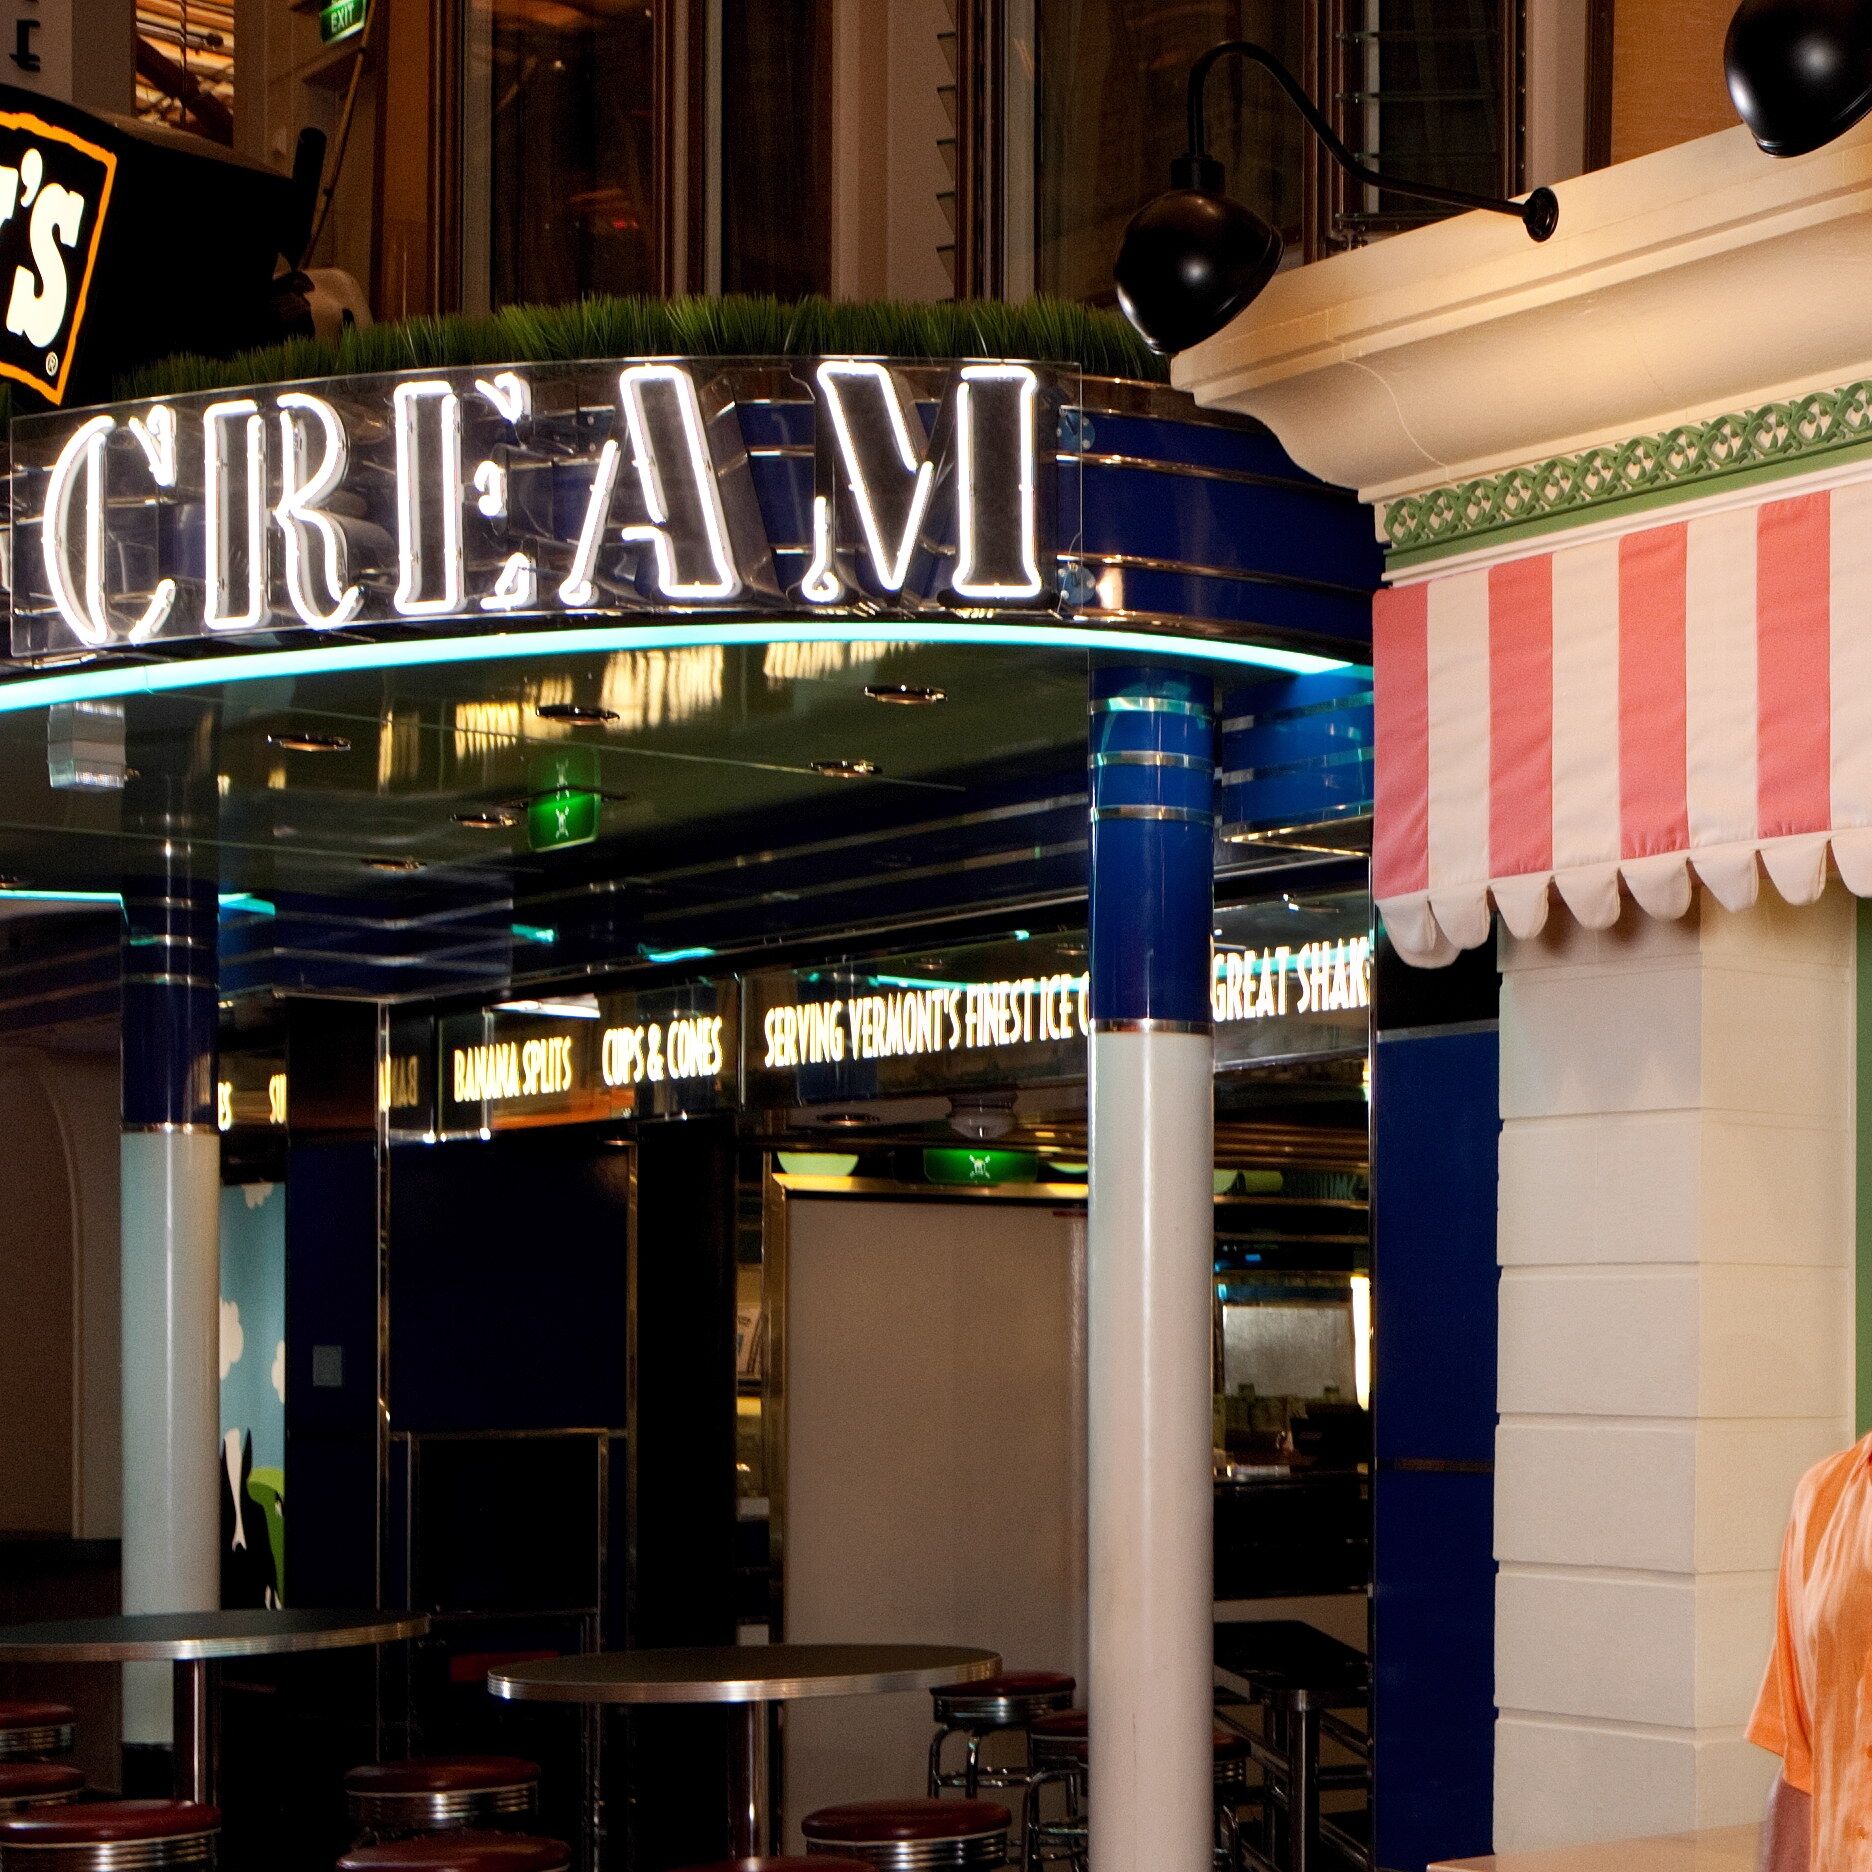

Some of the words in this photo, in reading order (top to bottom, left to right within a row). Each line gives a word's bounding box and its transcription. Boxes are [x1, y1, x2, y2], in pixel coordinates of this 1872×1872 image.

[331, 2, 355, 33] EXIT
[0, 148, 85, 348] 'S
[43, 361, 1043, 646] CREAM
[764, 1000, 845, 1068] SERVING
[848, 987, 962, 1062] VERMONT'S
[965, 977, 1036, 1050] FINEST
[1039, 973, 1073, 1041] ICE
[1210, 945, 1291, 1022] GREAT
[1297, 936, 1371, 1014] SHAK
[453, 1041, 521, 1103] BANANA
[521, 1035, 573, 1096] SPLITS
[601, 1024, 646, 1087] CUPS
[646, 1023, 665, 1082] &
[666, 1015, 723, 1080] CONES
